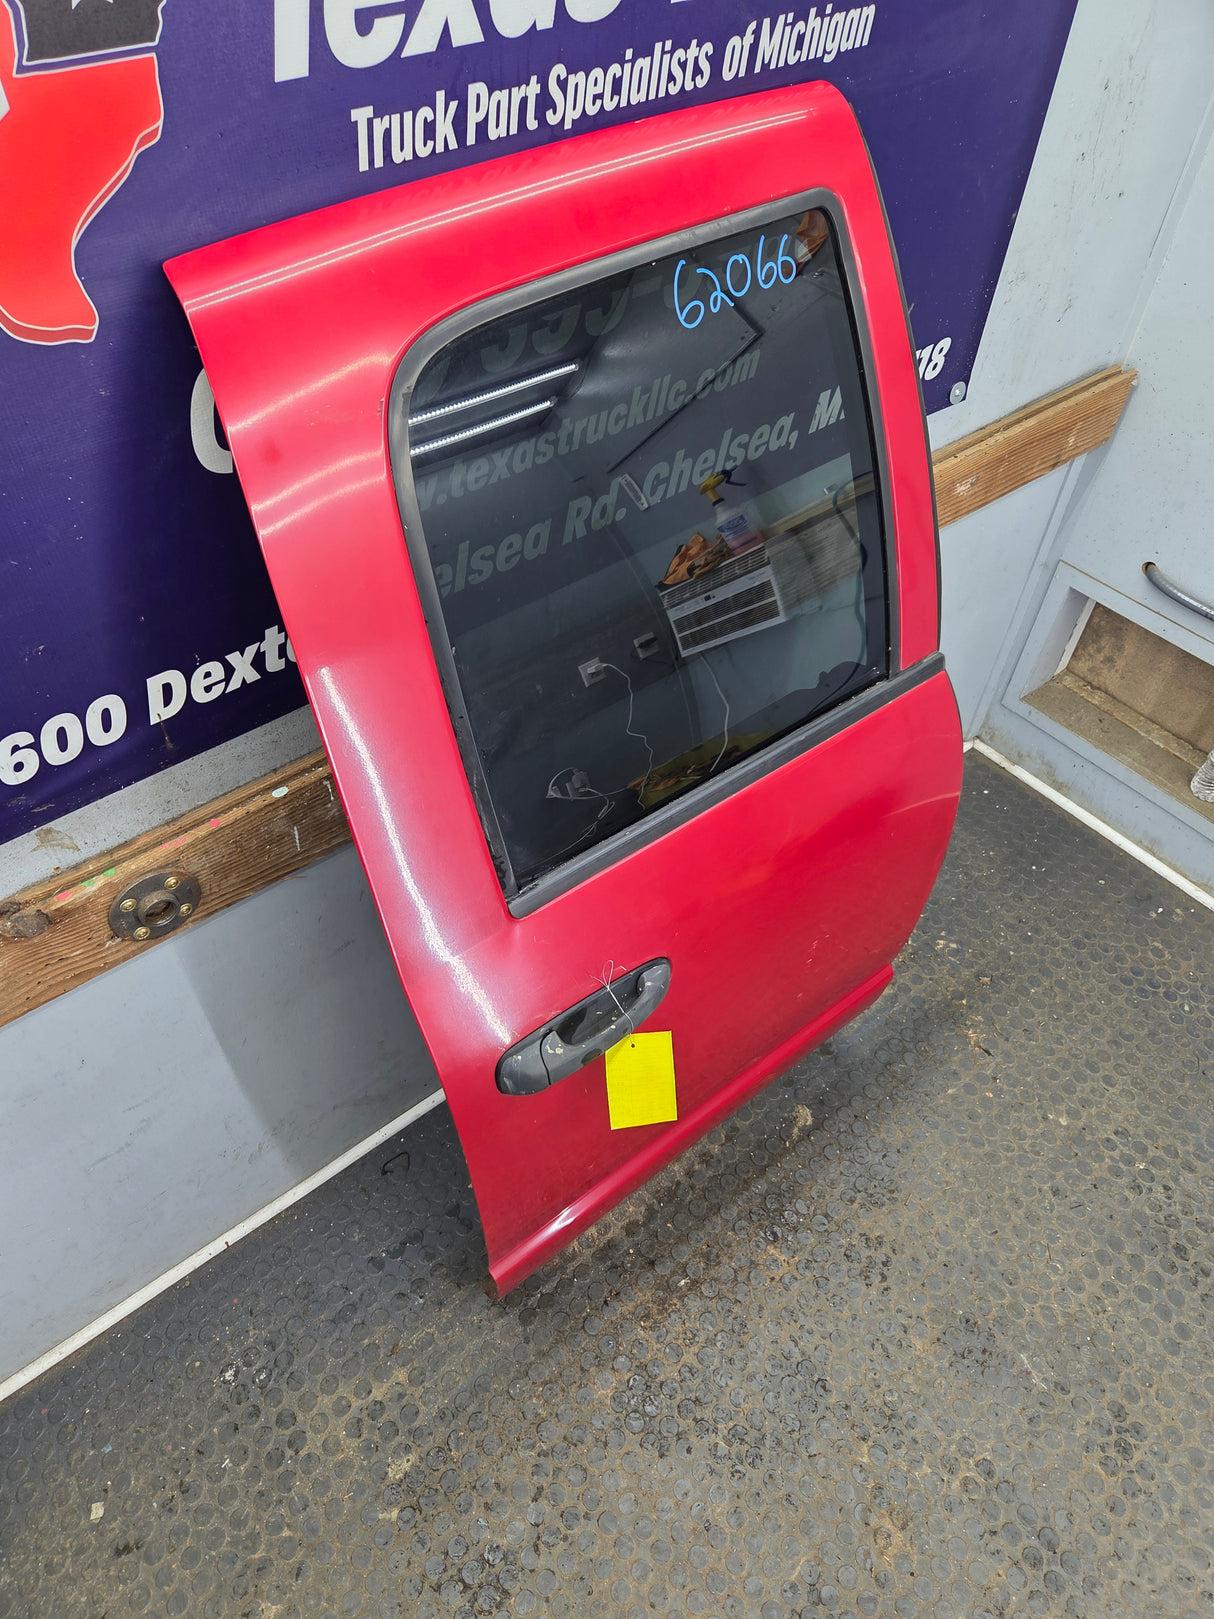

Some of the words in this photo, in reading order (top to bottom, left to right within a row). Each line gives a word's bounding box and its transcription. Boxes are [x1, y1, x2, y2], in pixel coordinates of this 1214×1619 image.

[350, 90, 459, 173] Truck
[466, 74, 541, 146] Part
[545, 38, 713, 130] Specialists
[721, 20, 757, 81] of
[754, 3, 876, 73] Michigan
[674, 233, 797, 329] 62066
[146, 625, 298, 726] Dext
[562, 477, 627, 545] Rd.
[642, 412, 799, 507] Chelsea,
